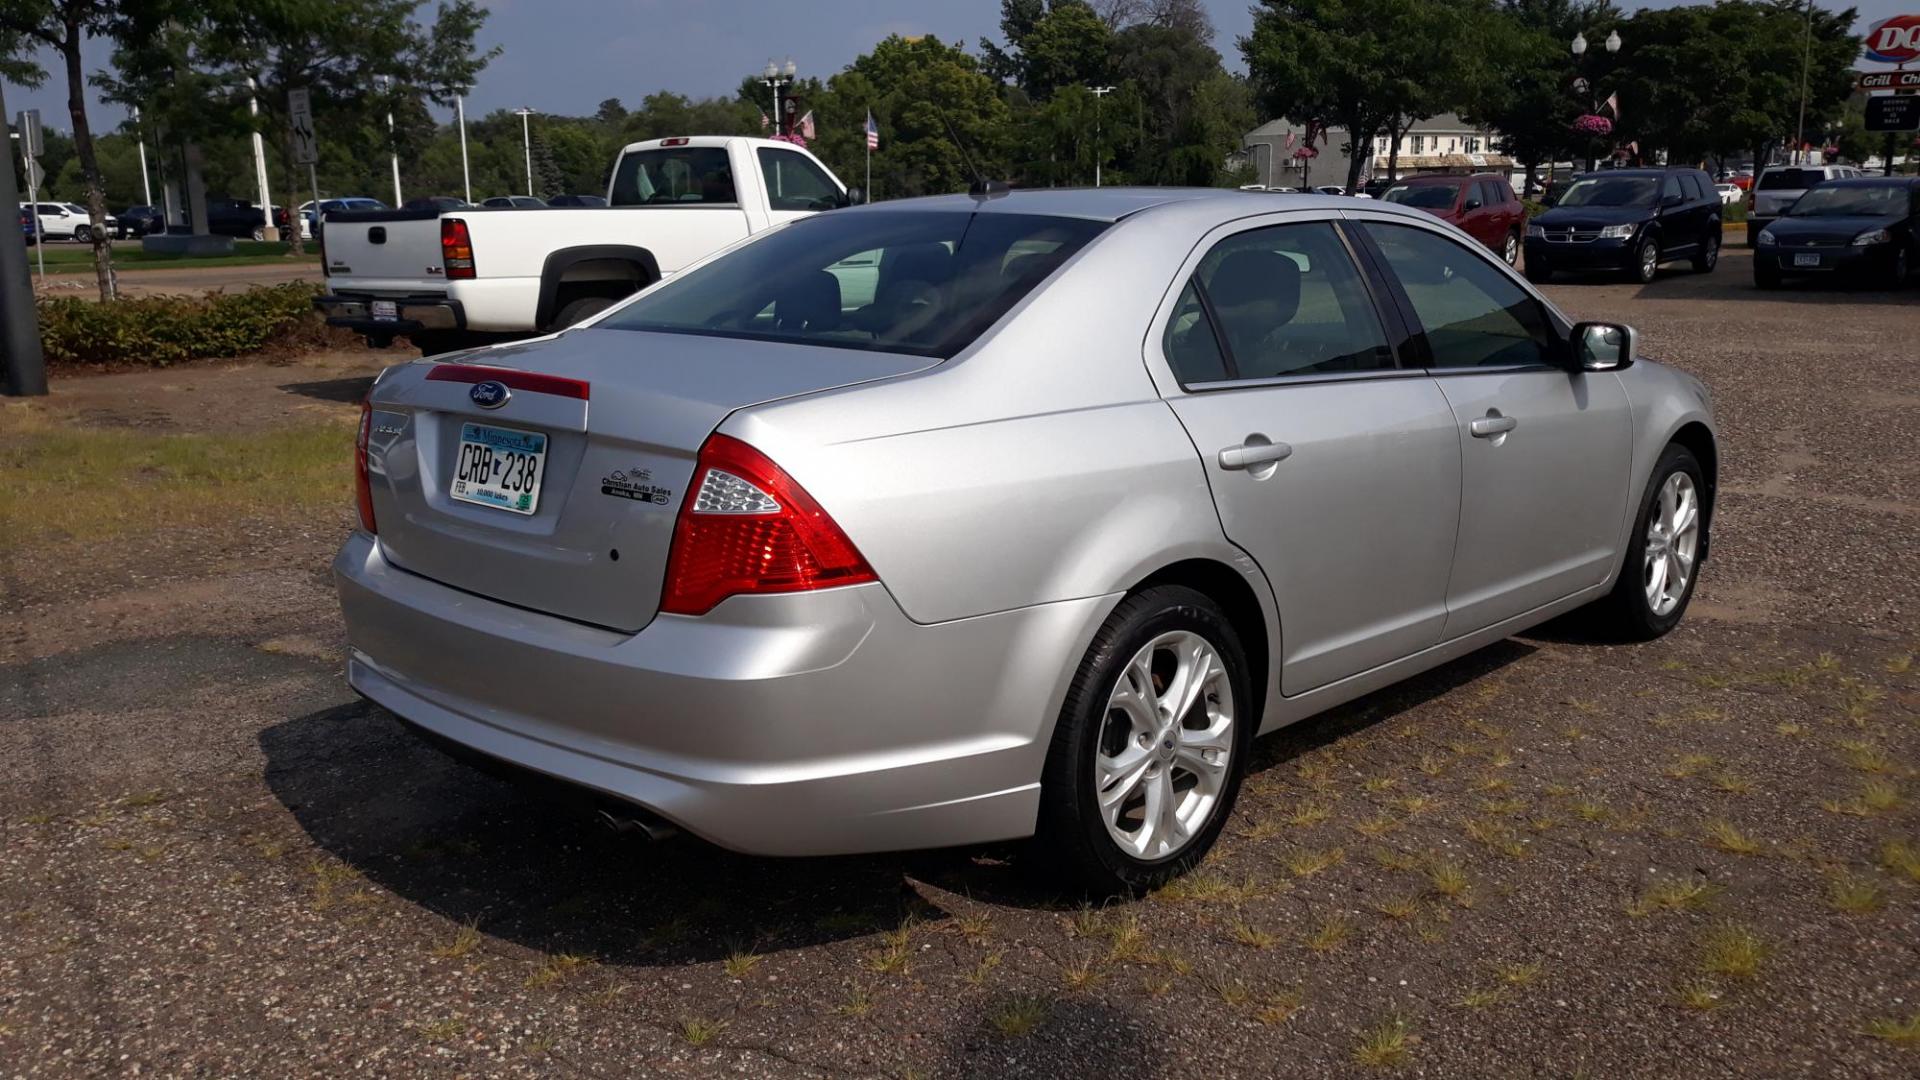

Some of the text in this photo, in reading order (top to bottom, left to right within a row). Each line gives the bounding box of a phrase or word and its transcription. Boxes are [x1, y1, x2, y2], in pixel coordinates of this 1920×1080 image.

[1875, 25, 1920, 51] DQ
[1863, 74, 1891, 86] Grill
[473, 383, 497, 400] Ford
[458, 443, 537, 494] CRB 238
[455, 481, 466, 493] FEB
[476, 488, 508, 501] 10,000 lakes
[602, 477, 672, 496] Christian Auto Sales
